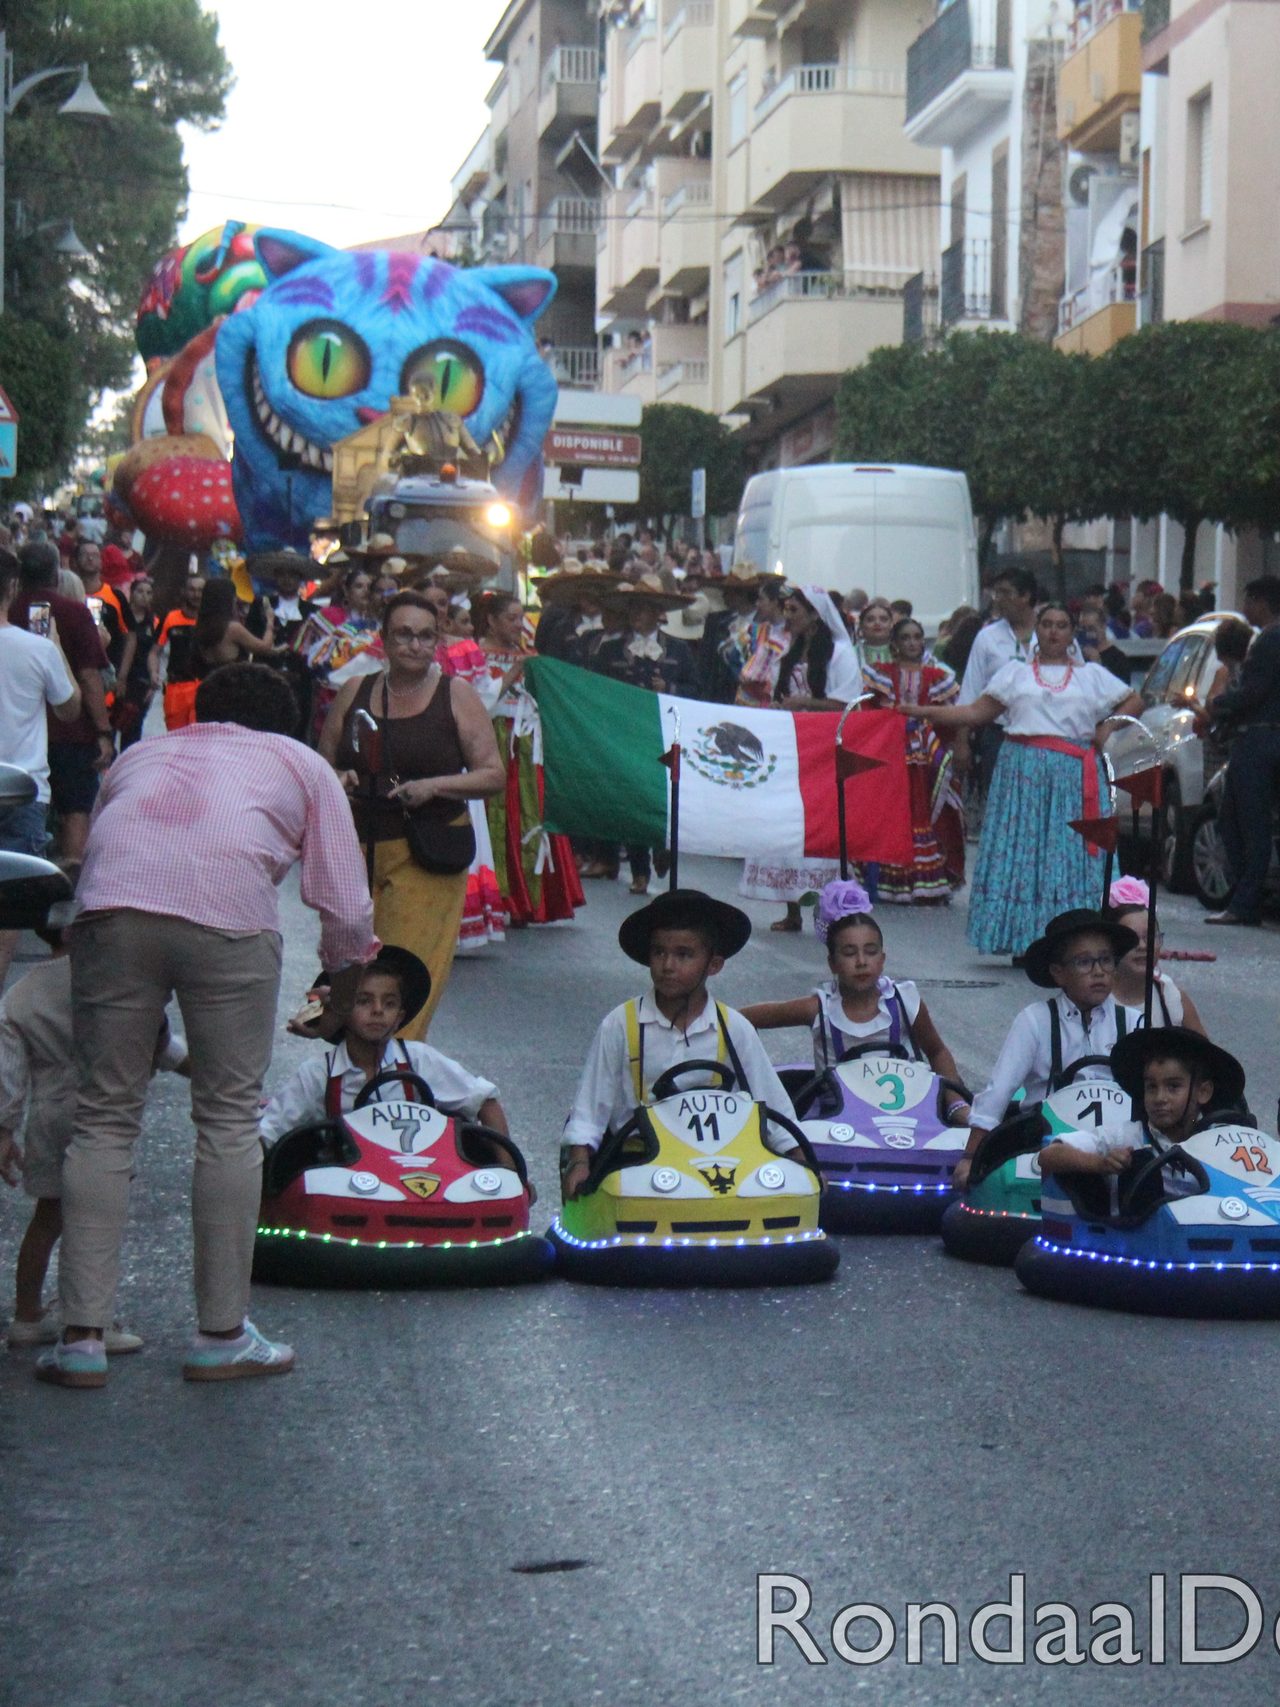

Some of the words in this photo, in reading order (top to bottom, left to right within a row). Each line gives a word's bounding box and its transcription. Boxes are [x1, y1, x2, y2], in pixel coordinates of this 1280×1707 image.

[553, 435, 624, 452] DISPONIBLE
[863, 1061, 915, 1078] AUTO
[875, 1074, 906, 1110] 3
[1076, 1088, 1124, 1105] AUTO
[372, 1104, 431, 1126] AUTO
[678, 1095, 737, 1117] AUTO
[1077, 1101, 1103, 1128] 1
[391, 1119, 421, 1153] 7
[687, 1113, 720, 1141] 11
[1215, 1131, 1267, 1149] AUTO
[1230, 1146, 1273, 1175] 12
